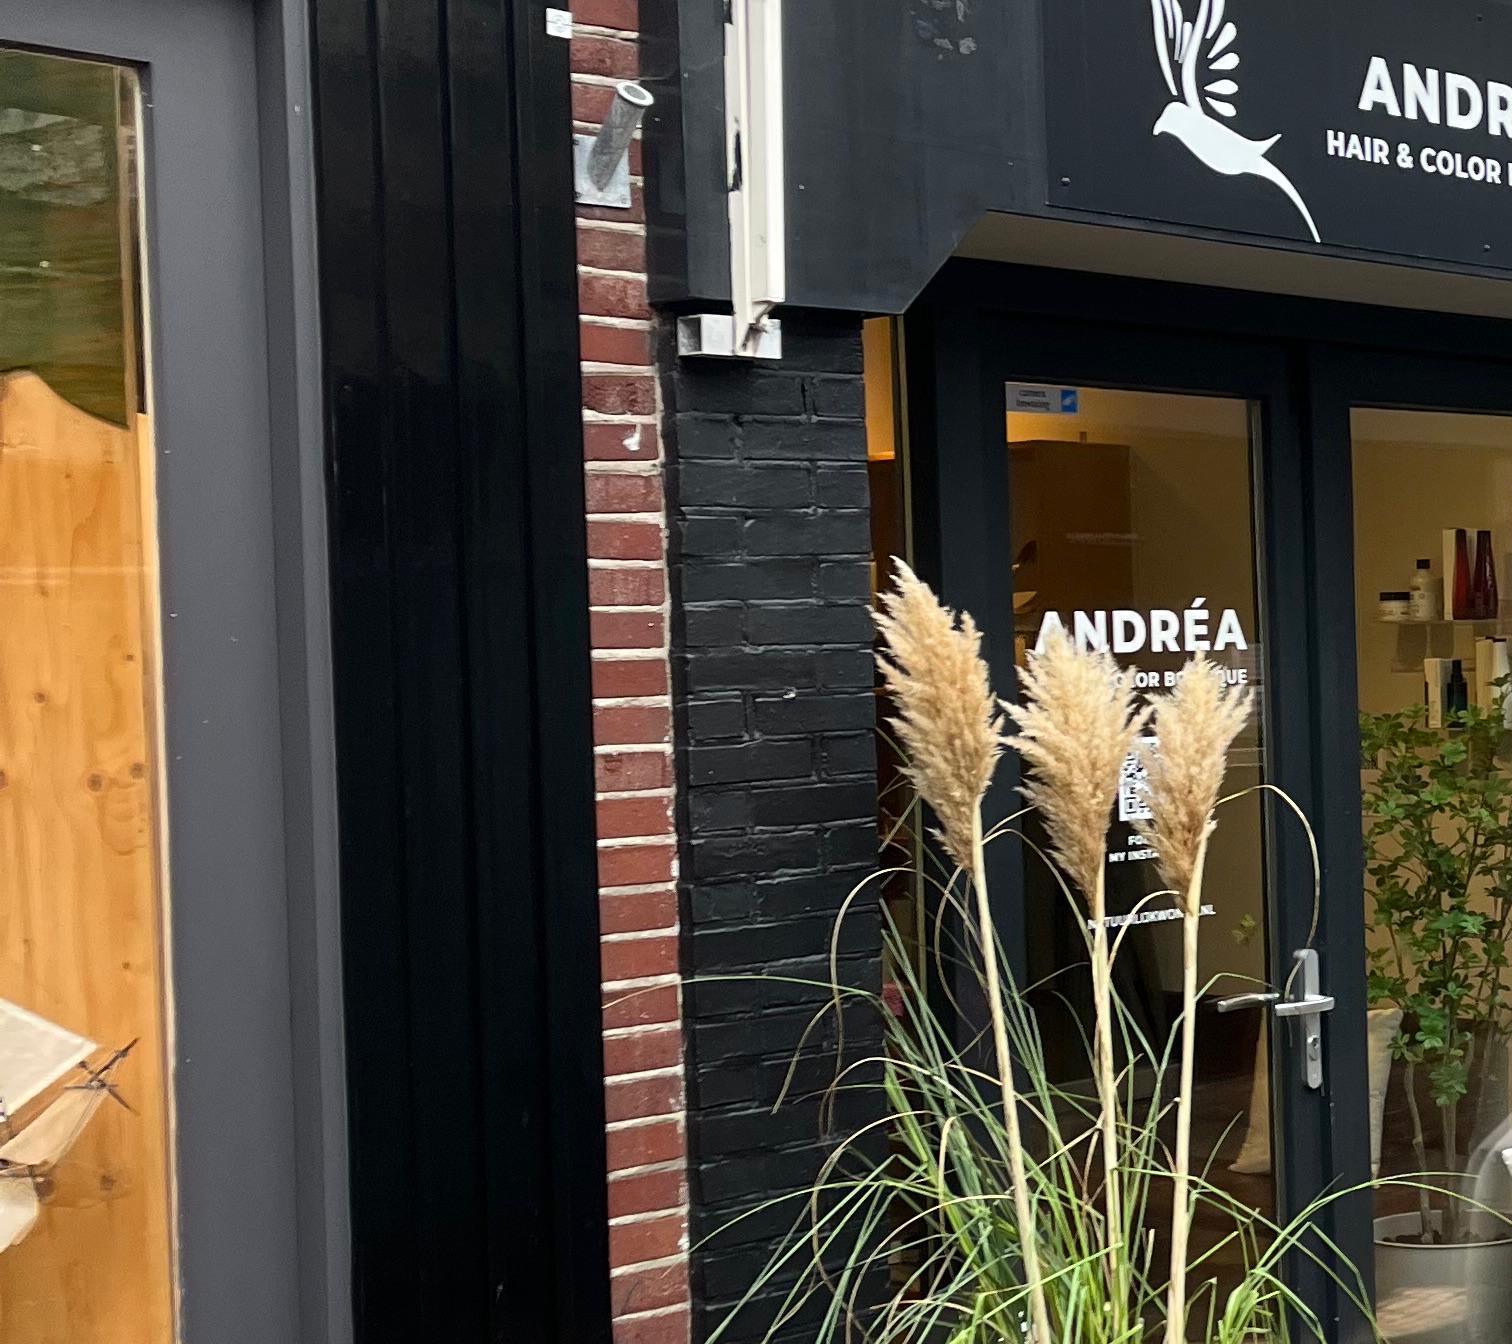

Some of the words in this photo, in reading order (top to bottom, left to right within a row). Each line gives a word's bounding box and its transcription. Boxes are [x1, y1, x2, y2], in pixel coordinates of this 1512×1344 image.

[1326, 129, 1390, 165] HAIR
[1396, 143, 1414, 169] &
[1420, 147, 1501, 184] COLOR
[1034, 597, 1249, 655] ANDRÉA
